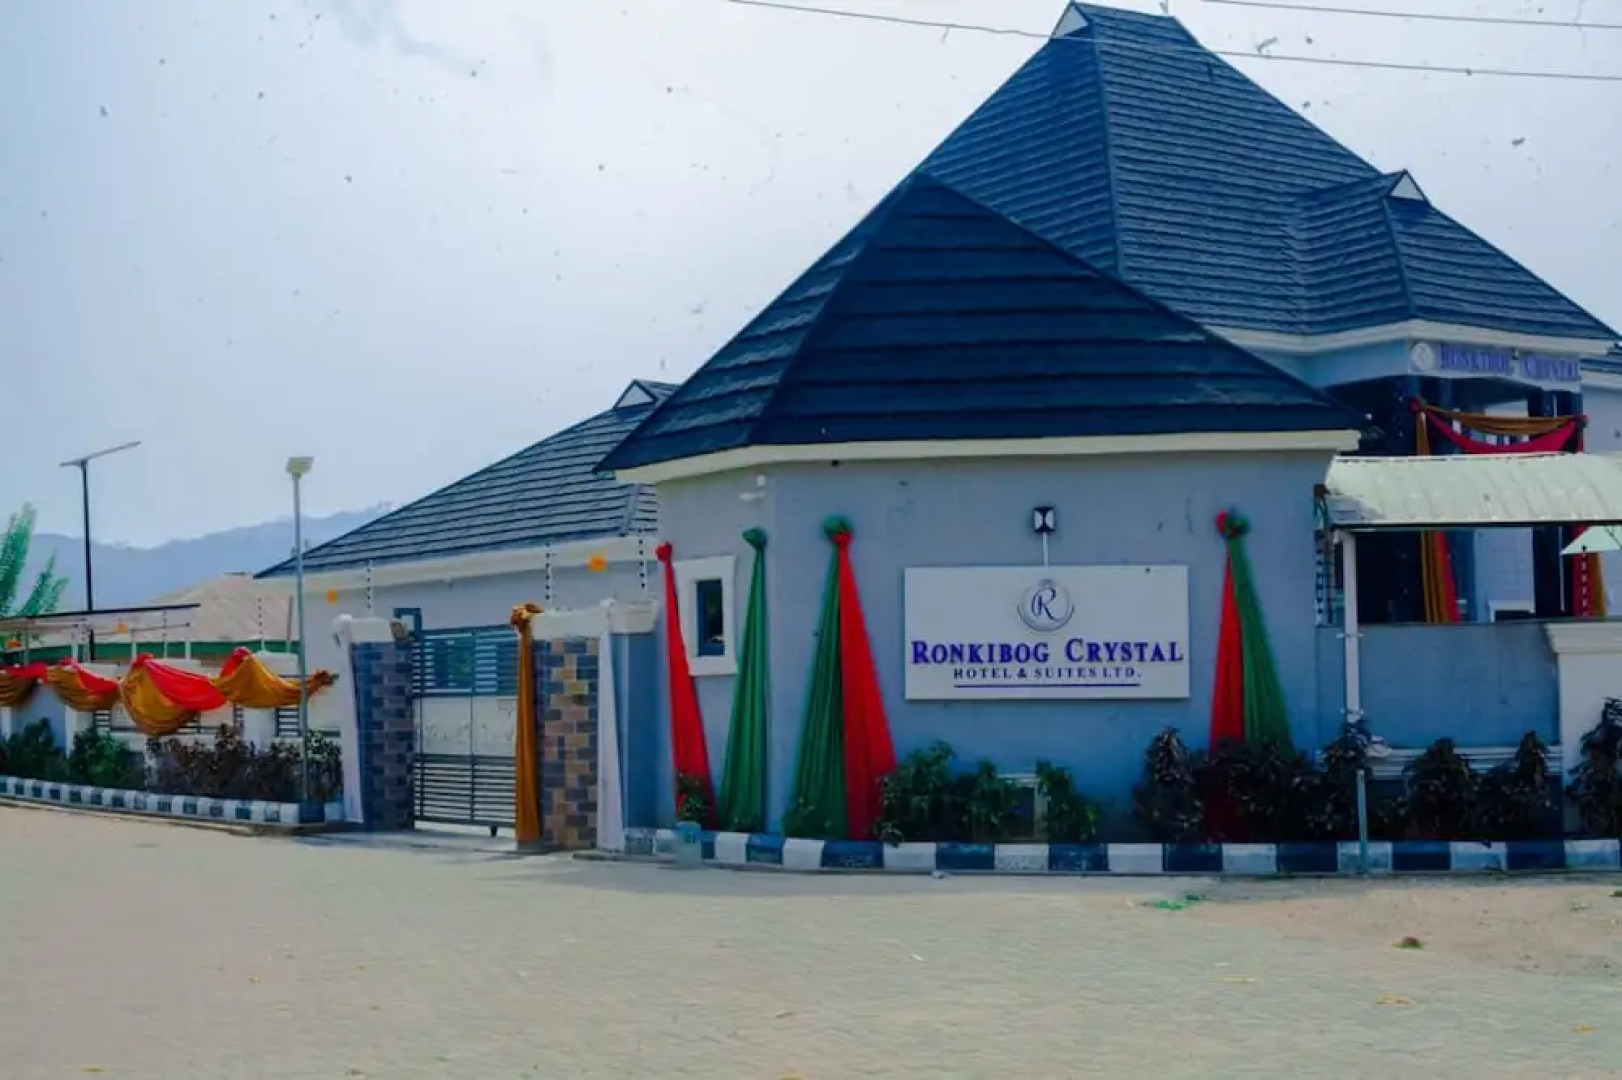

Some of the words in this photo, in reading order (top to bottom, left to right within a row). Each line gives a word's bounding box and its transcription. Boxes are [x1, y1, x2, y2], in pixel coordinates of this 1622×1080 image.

[911, 640, 1050, 664] RONKIBOG
[1065, 638, 1184, 662] CRYSTAL
[953, 668, 1012, 679] HOTEL
[1017, 667, 1028, 679] &
[1034, 667, 1097, 679] SUITES
[1102, 667, 1142, 679] LTD.
